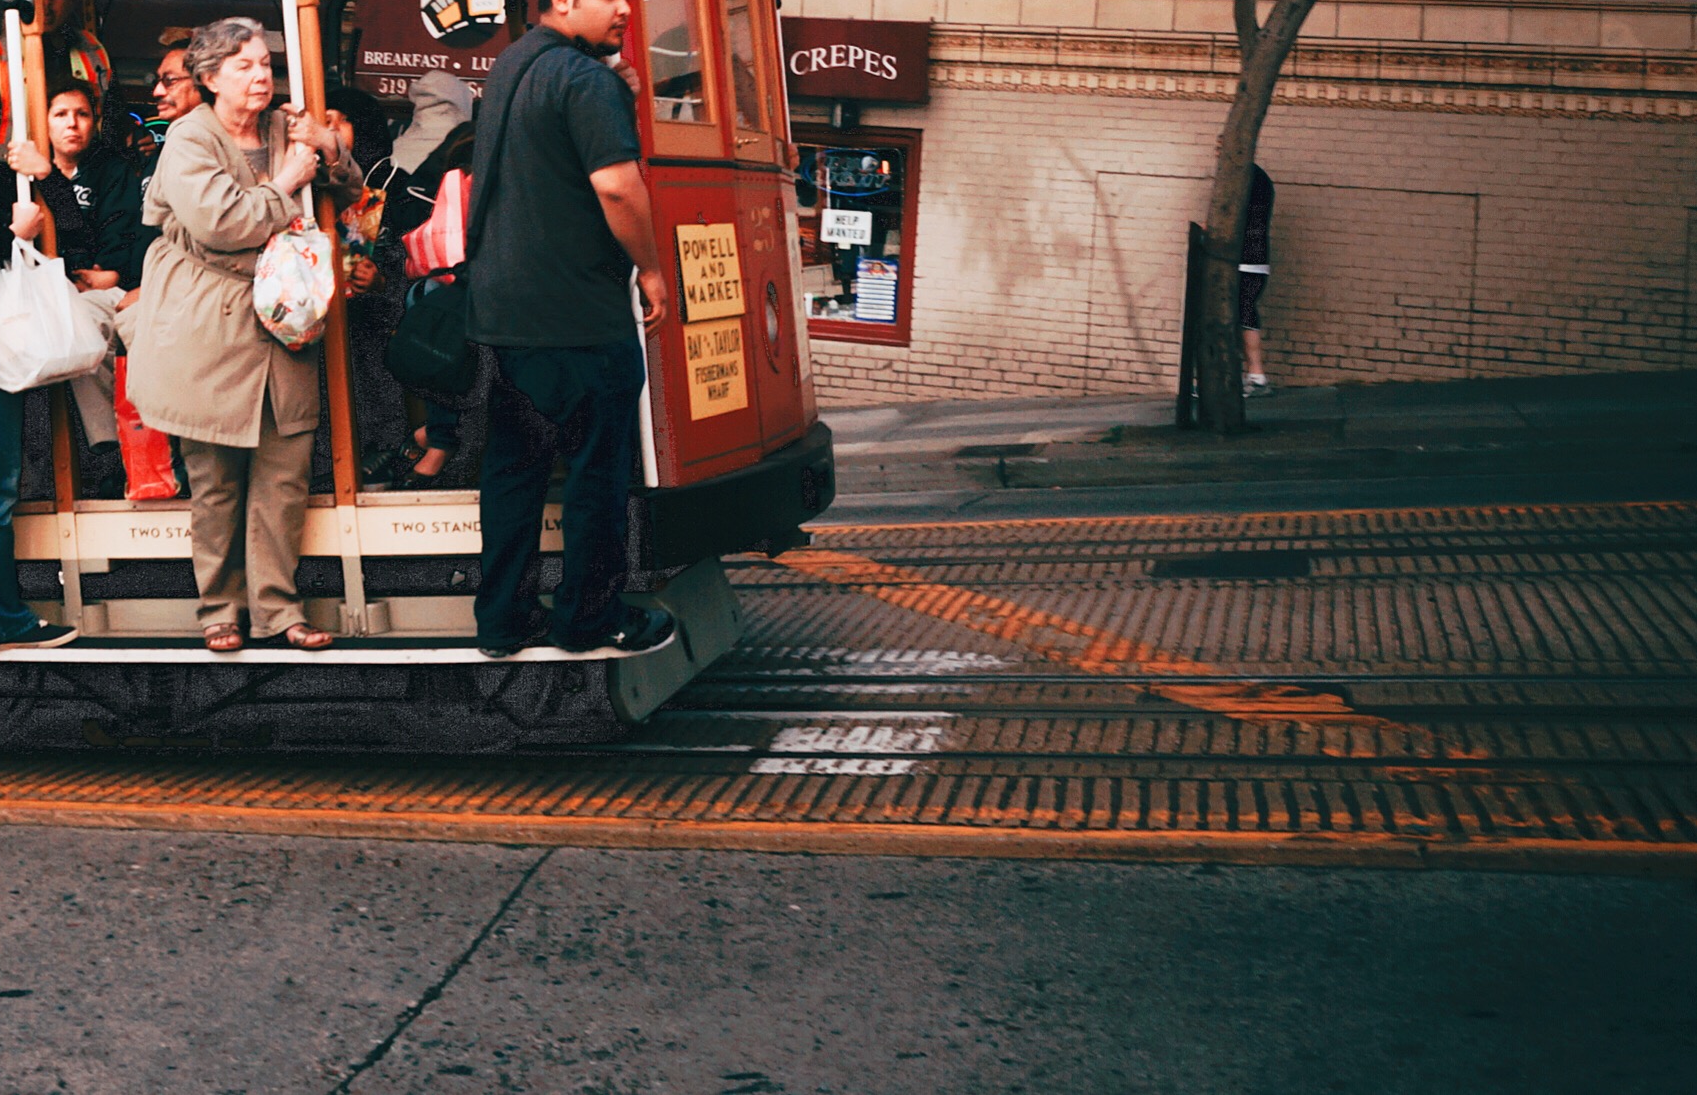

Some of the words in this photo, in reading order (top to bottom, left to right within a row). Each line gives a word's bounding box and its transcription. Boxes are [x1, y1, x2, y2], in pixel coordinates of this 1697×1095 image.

[364, 50, 450, 69] BREAKFAST
[789, 44, 898, 81] CREPES
[378, 77, 407, 94] 519
[835, 215, 859, 226] HELP
[826, 227, 866, 240] WANTED
[683, 237, 735, 261] POWELL
[701, 262, 725, 279] AND
[687, 279, 740, 304] MARKET
[129, 527, 160, 539] TWO
[392, 522, 426, 533] TWO
